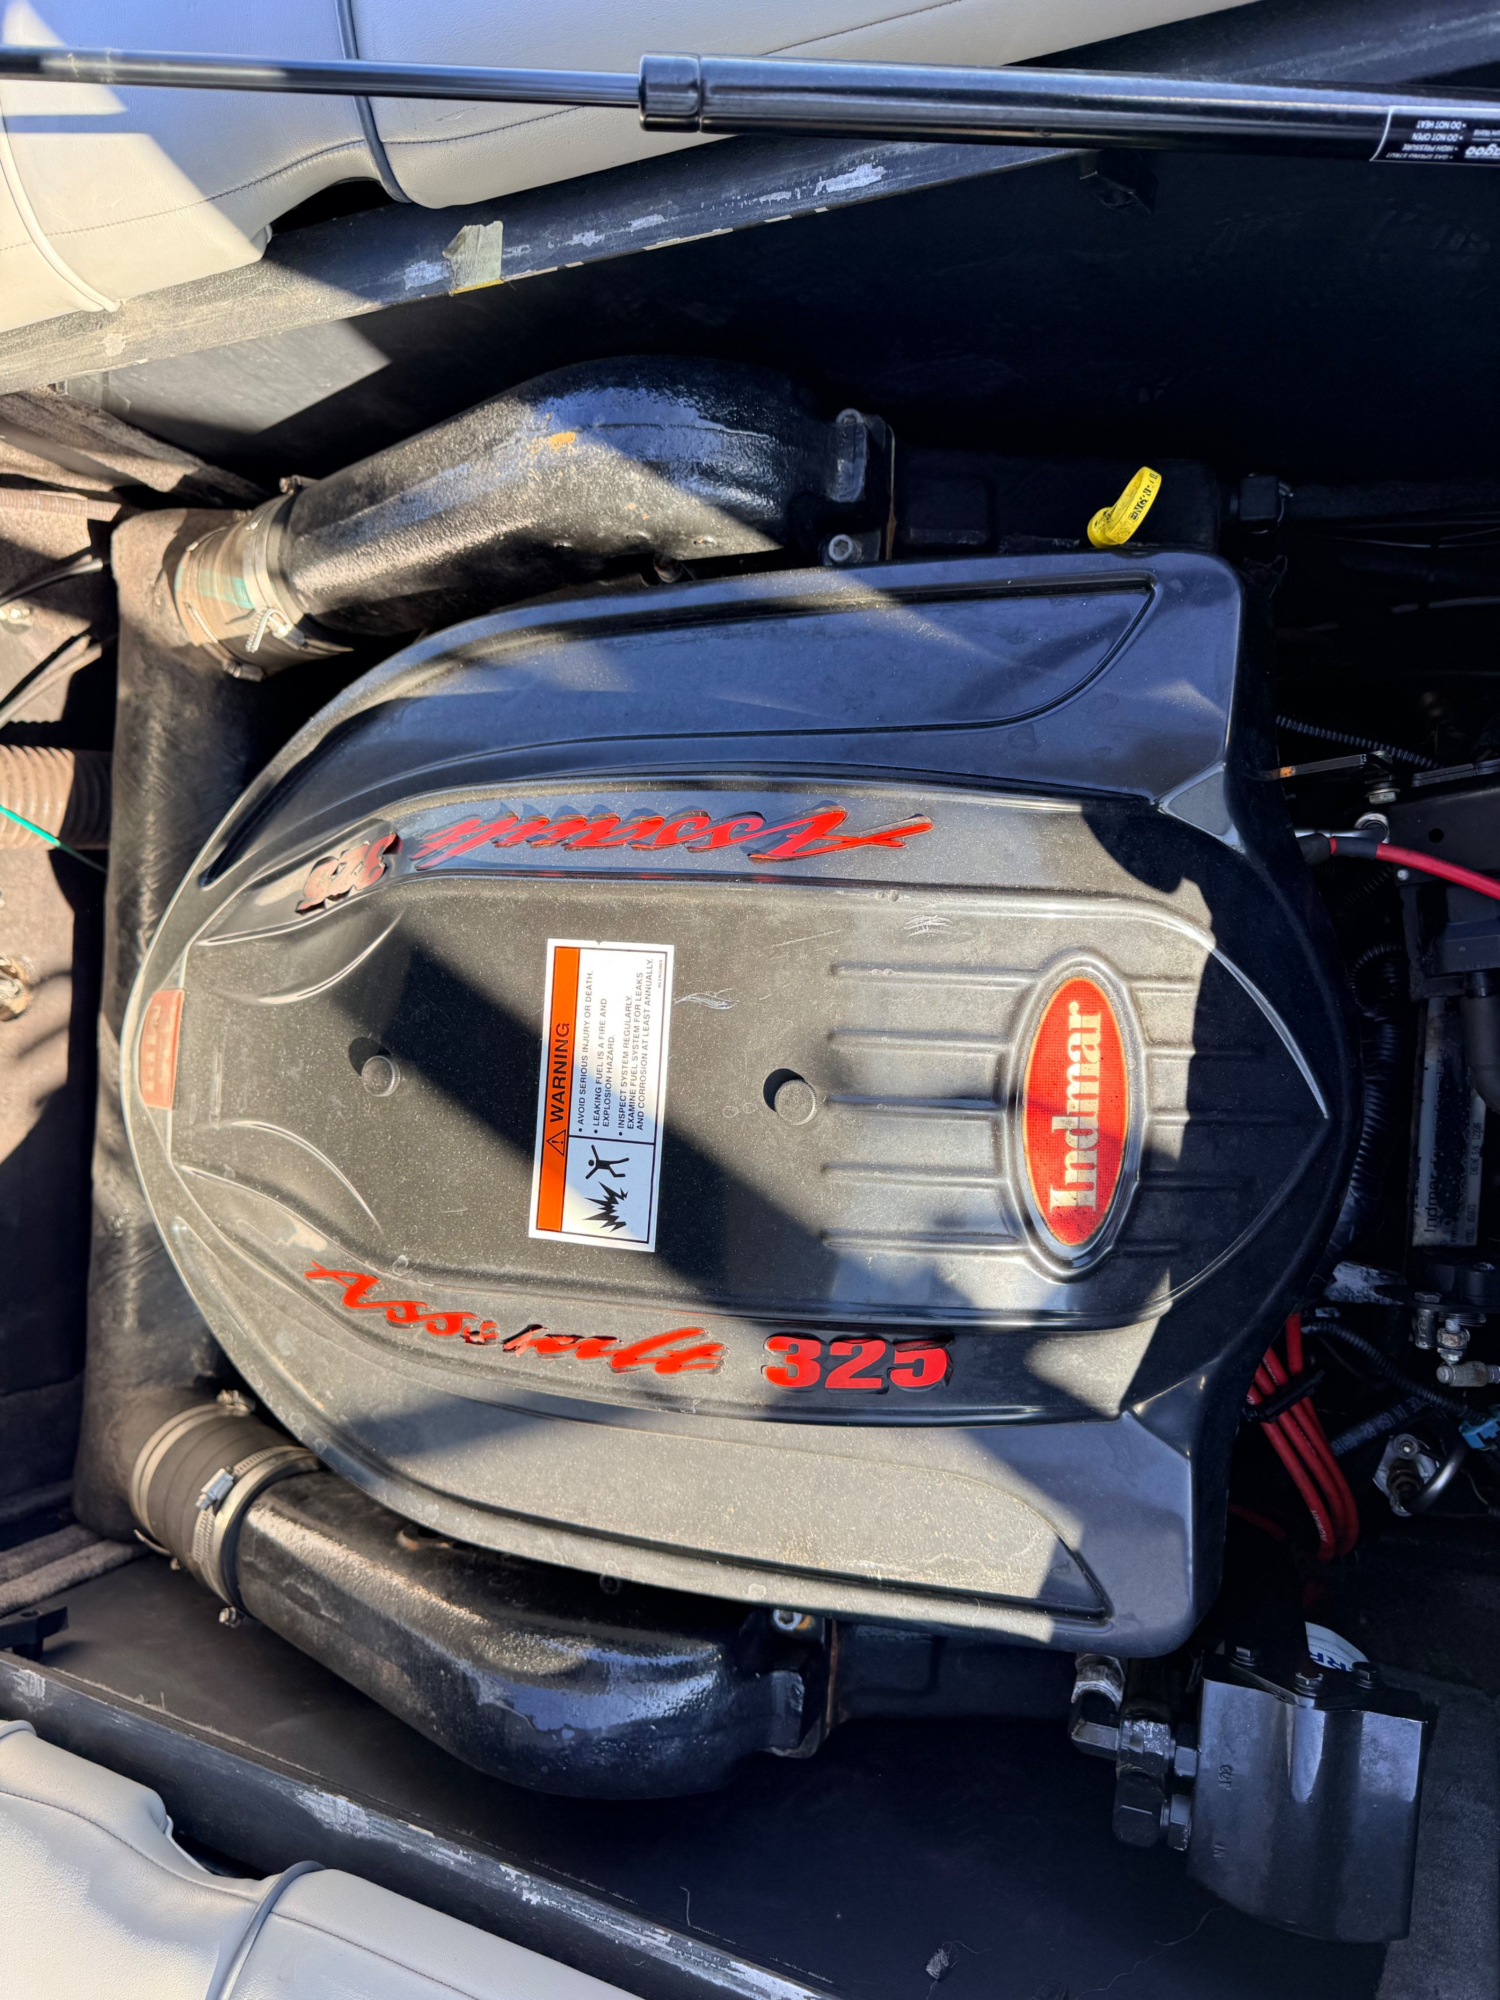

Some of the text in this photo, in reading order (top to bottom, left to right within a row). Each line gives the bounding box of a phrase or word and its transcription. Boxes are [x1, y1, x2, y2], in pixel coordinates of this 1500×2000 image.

[1416, 120, 1462, 129] DO NOT HEAT
[1432, 133, 1447, 141] NOT
[1447, 133, 1458, 141] DO
[409, 804, 934, 871] Assault
[644, 959, 653, 1006] ANNUALLY.
[585, 1005, 591, 1018] OR
[643, 1009, 651, 1037] LEAST
[582, 1021, 591, 1052] INJURY
[598, 1020, 606, 1040] FIRE
[632, 1025, 640, 1061] SYSTEM
[642, 1039, 649, 1050] AT
[598, 1051, 604, 1059] IS
[618, 995, 632, 1128] INSPECT SYSTEM REGULARLY.
[550, 1022, 570, 1122] WARNING
[580, 1056, 588, 1095] SERIOUS
[595, 1062, 603, 1084] FUEL
[603, 1035, 615, 1127] EXPLOSION HAZARD.
[630, 1064, 638, 1086] FUEL
[639, 1053, 648, 1108] CORROSION
[578, 1097, 586, 1125] AVOID
[593, 1087, 602, 1126] LEAKING
[628, 1089, 636, 1129] EXAMINE
[1050, 1001, 1102, 1212] Indmar
[763, 1333, 954, 1391] 325
